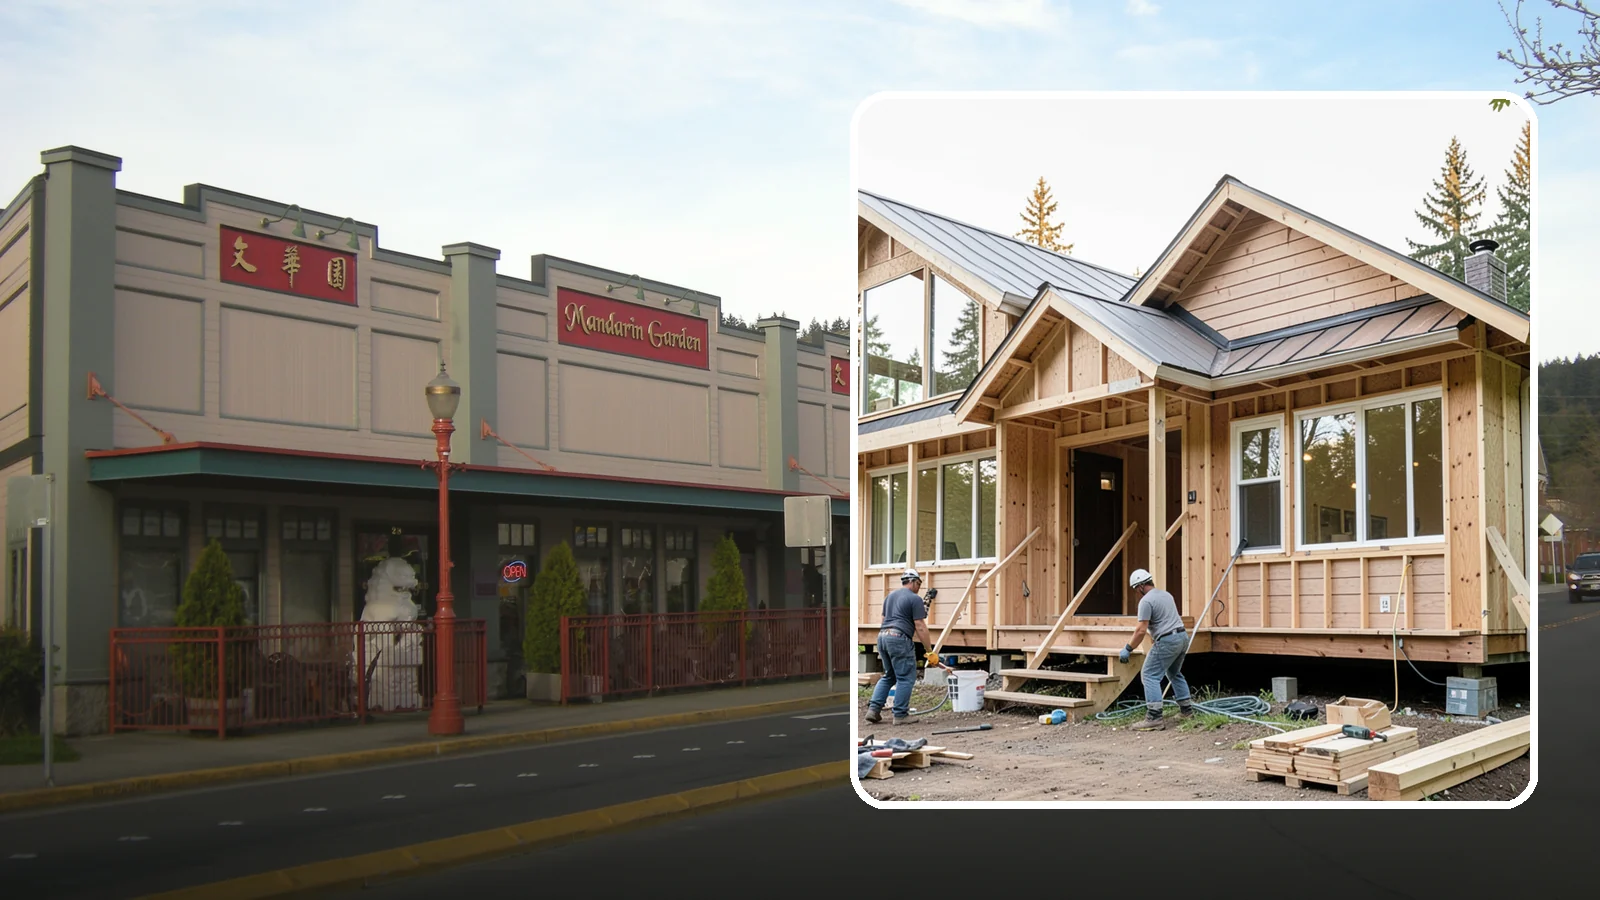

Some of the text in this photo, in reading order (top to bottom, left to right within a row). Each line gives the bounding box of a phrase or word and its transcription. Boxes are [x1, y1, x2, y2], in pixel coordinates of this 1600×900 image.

[231, 235, 346, 291] 文華園
[564, 302, 701, 352] Mandarin Garden
[502, 565, 527, 578] OPEN
